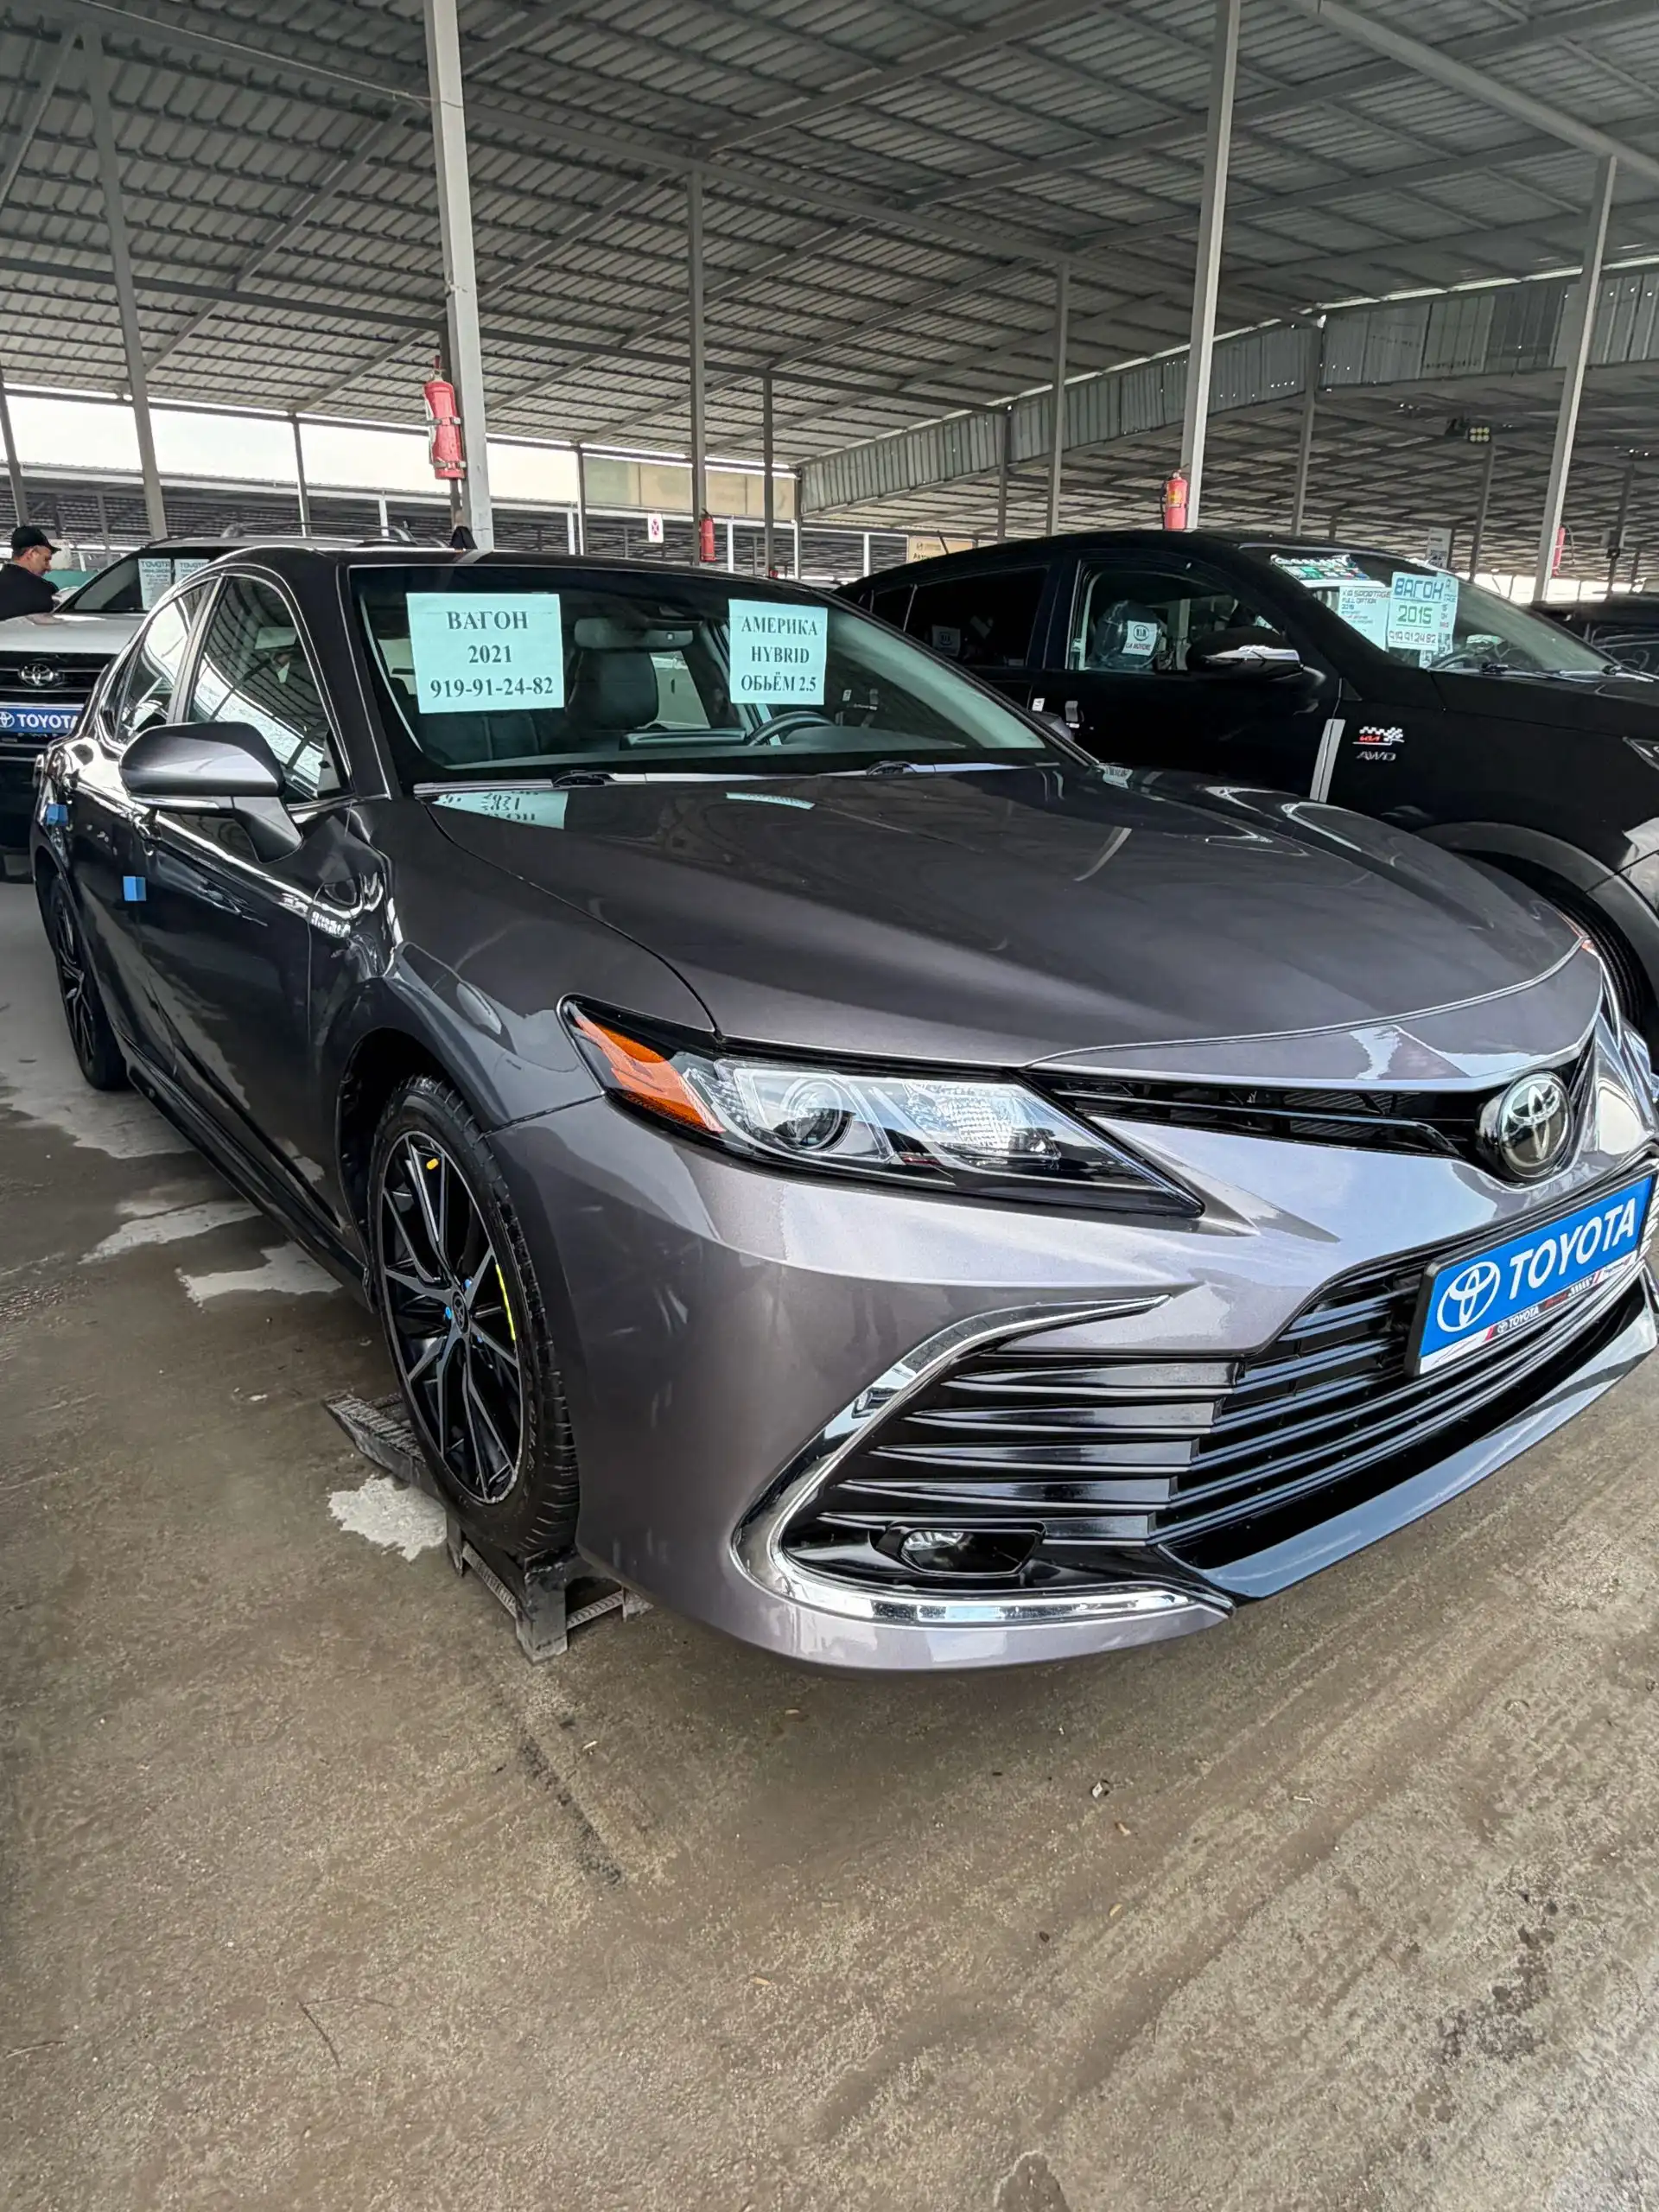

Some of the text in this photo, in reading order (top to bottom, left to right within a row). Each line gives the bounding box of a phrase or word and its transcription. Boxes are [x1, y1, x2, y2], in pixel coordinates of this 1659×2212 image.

[1395, 577, 1444, 600] ВАГОН
[447, 611, 529, 630] ВАГОН
[1397, 605, 1433, 625] 2015
[741, 615, 818, 636] АМЕРИКА
[467, 645, 512, 664] 2021
[751, 645, 810, 664] HYBRID
[430, 677, 554, 698] 919-91-24-82
[798, 676, 817, 692] 2.5
[1356, 750, 1396, 761] AWD
[1509, 1197, 1637, 1300] TOYOTA
[1509, 1306, 1540, 1328] TOYOTA
